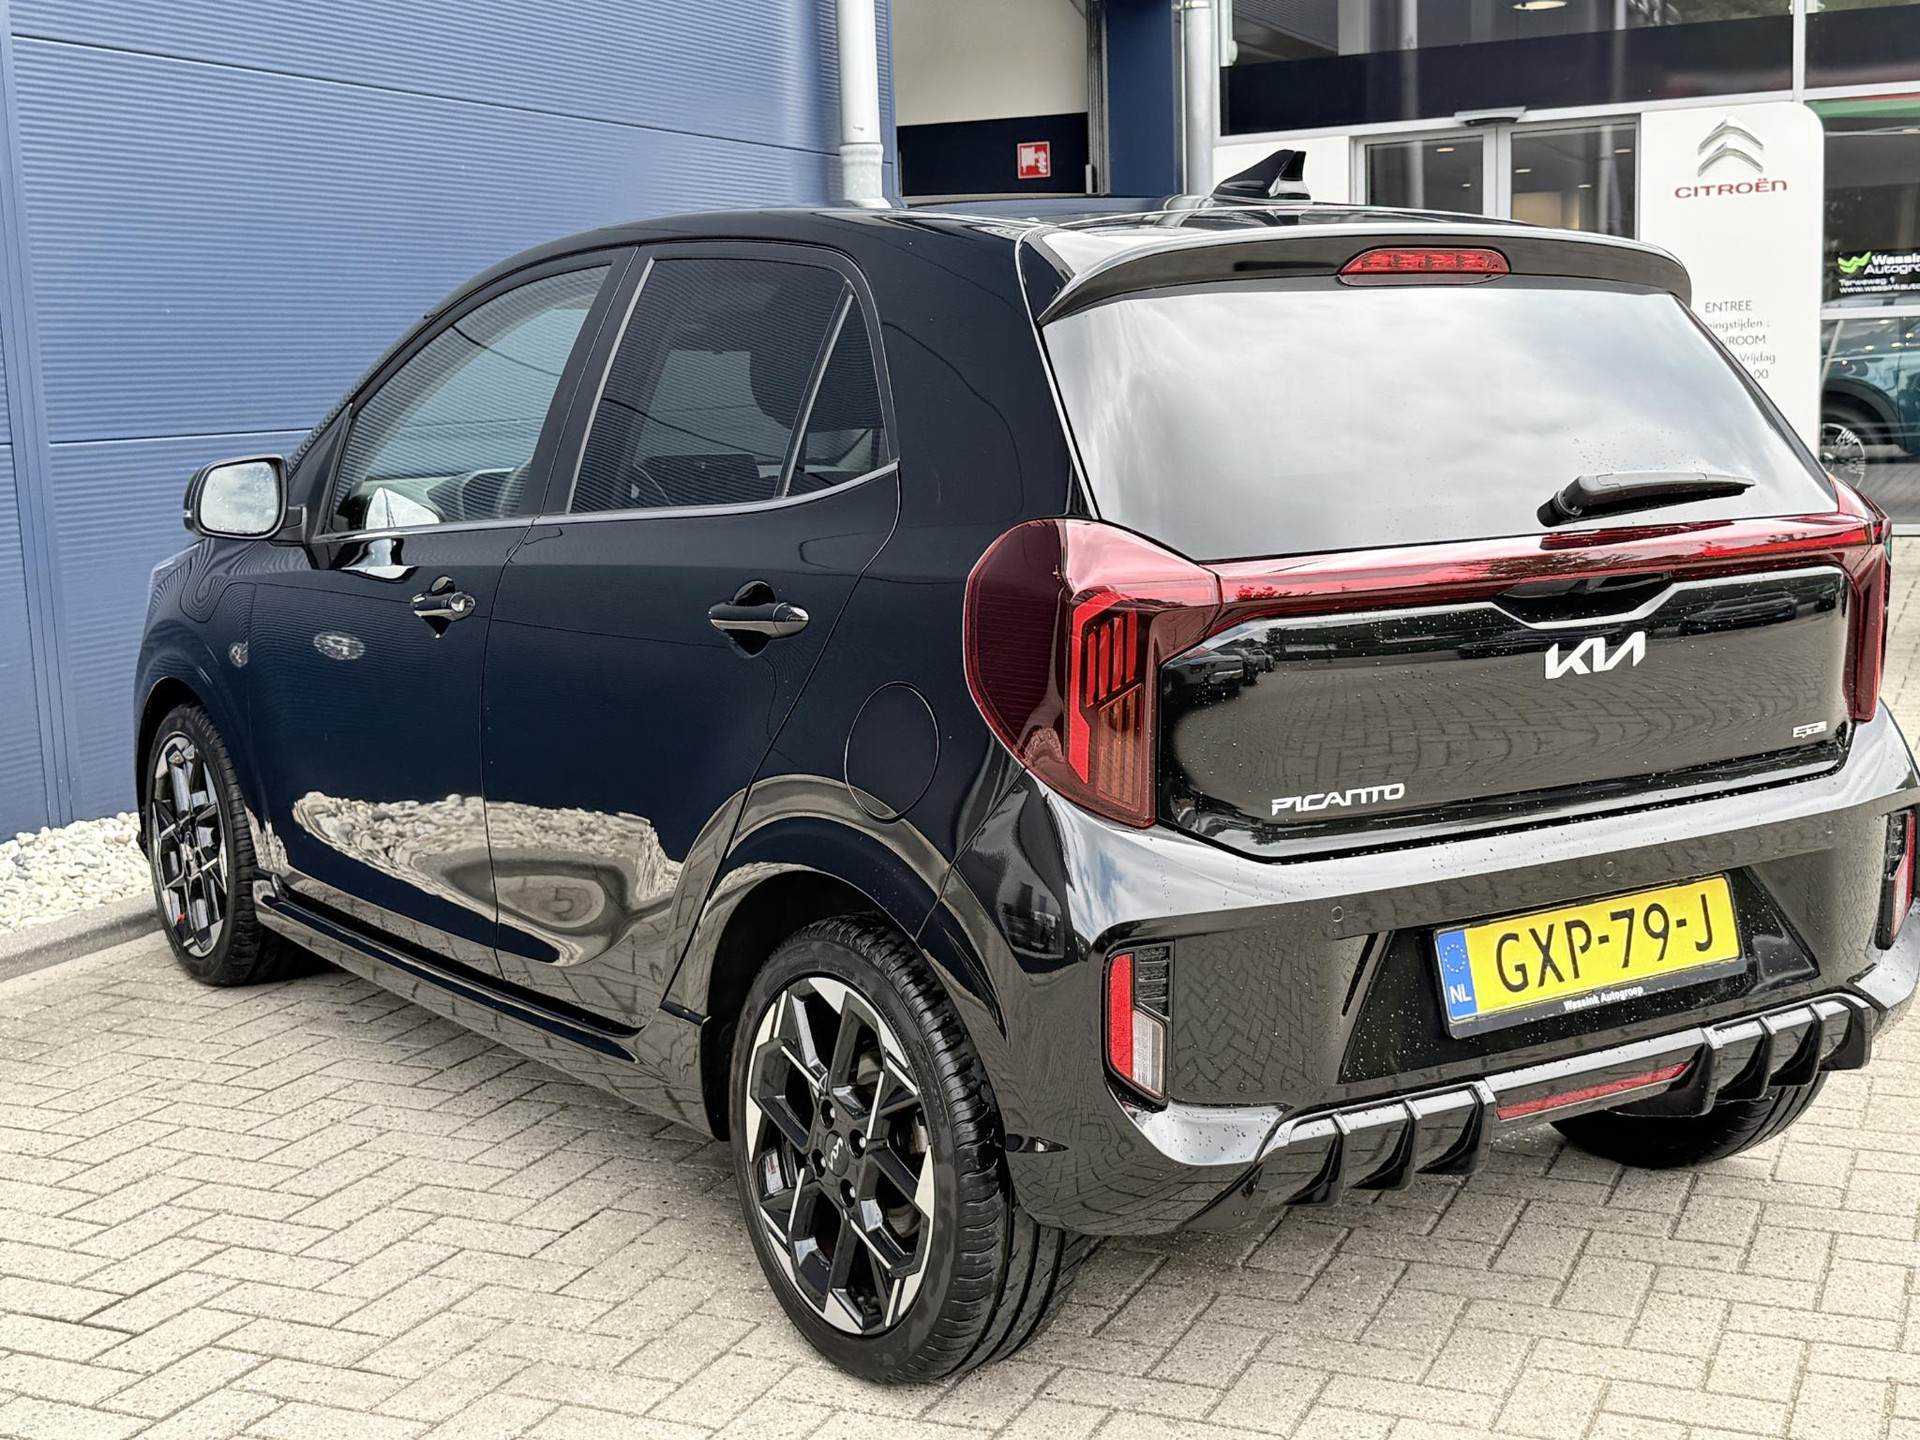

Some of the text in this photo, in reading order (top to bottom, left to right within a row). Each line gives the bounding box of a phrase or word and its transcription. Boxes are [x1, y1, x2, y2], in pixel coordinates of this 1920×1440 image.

[1674, 178, 1788, 199] CITROËN
[1704, 300, 1753, 313] ENTREE
[1739, 351, 1776, 365] Vrijdag
[1545, 631, 1646, 680] KIA
[1271, 782, 1405, 816] PICANTO
[1496, 893, 1713, 993] GXP-79-J
[1449, 984, 1473, 1005] NL
[1563, 985, 1644, 1011] Wassink Autogroep
